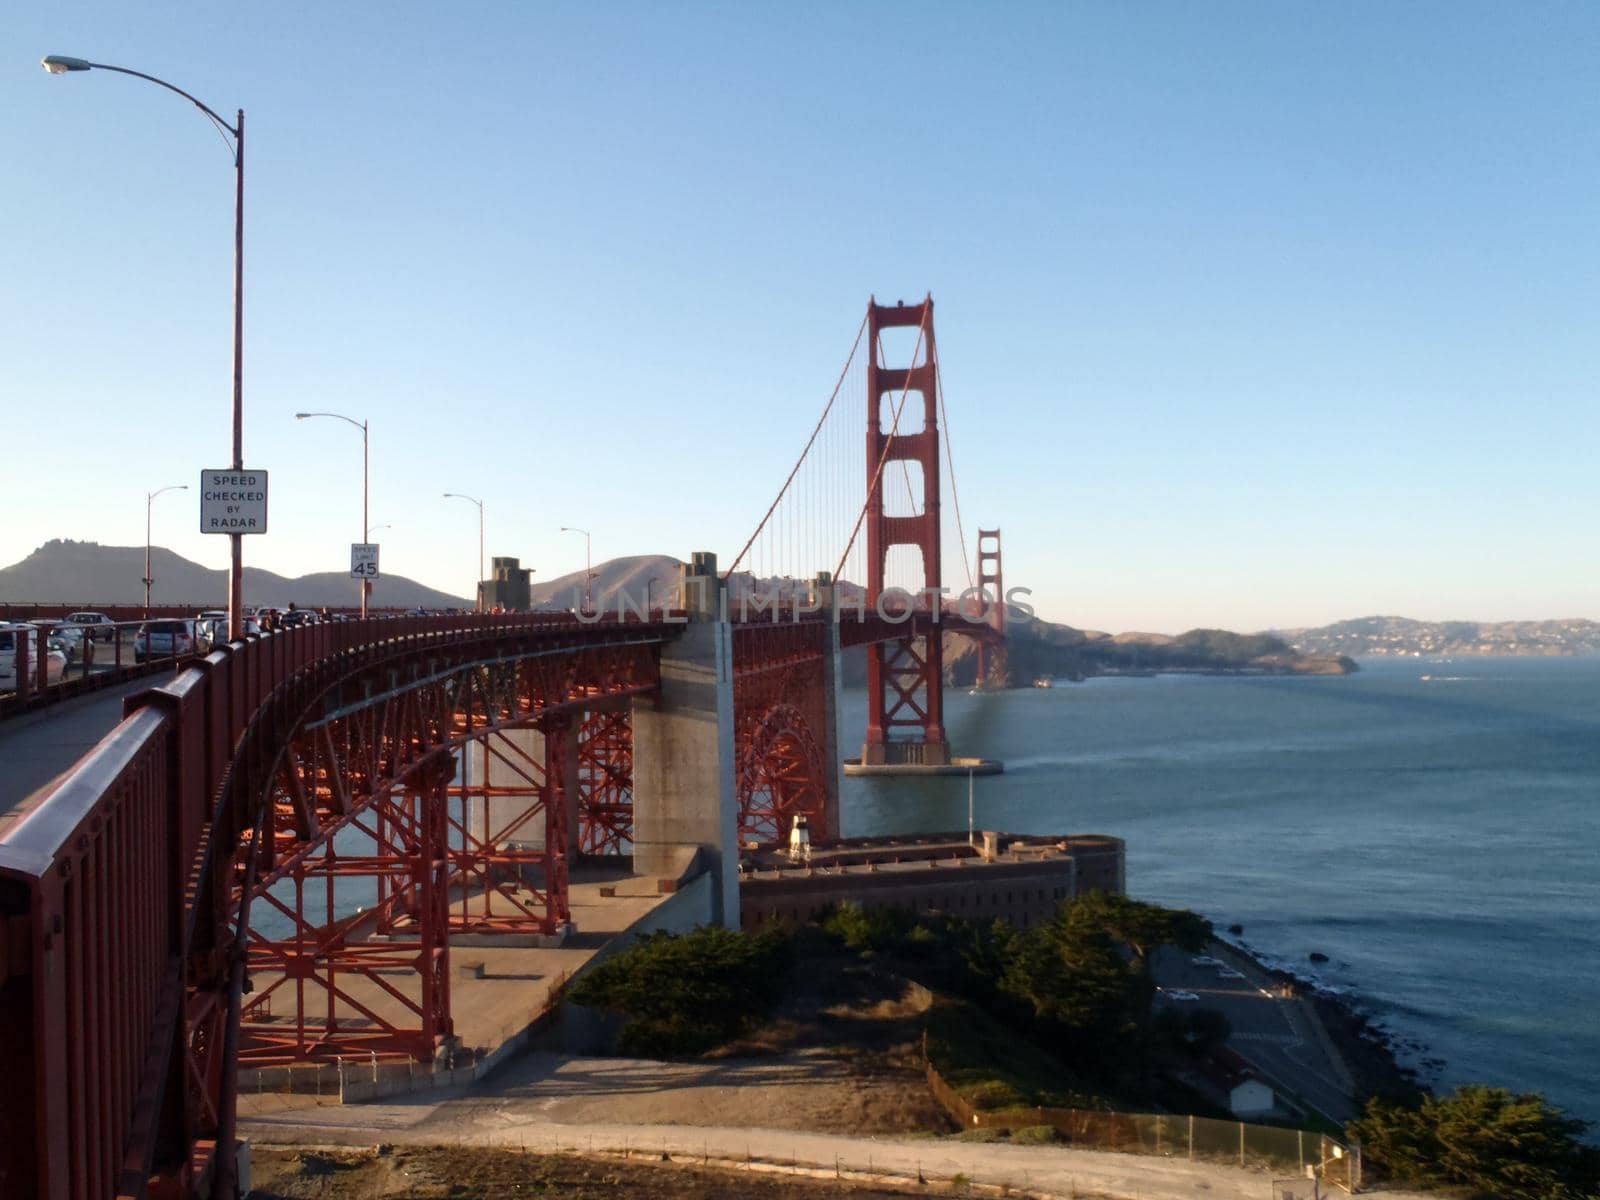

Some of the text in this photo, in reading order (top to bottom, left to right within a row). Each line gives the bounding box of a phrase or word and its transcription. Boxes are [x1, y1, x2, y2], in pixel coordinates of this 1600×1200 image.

[213, 476, 256, 486] SPEED
[204, 491, 264, 501] CHECKED
[227, 505, 240, 514] BY
[211, 518, 256, 528] RADAR
[353, 562, 377, 576] 45
